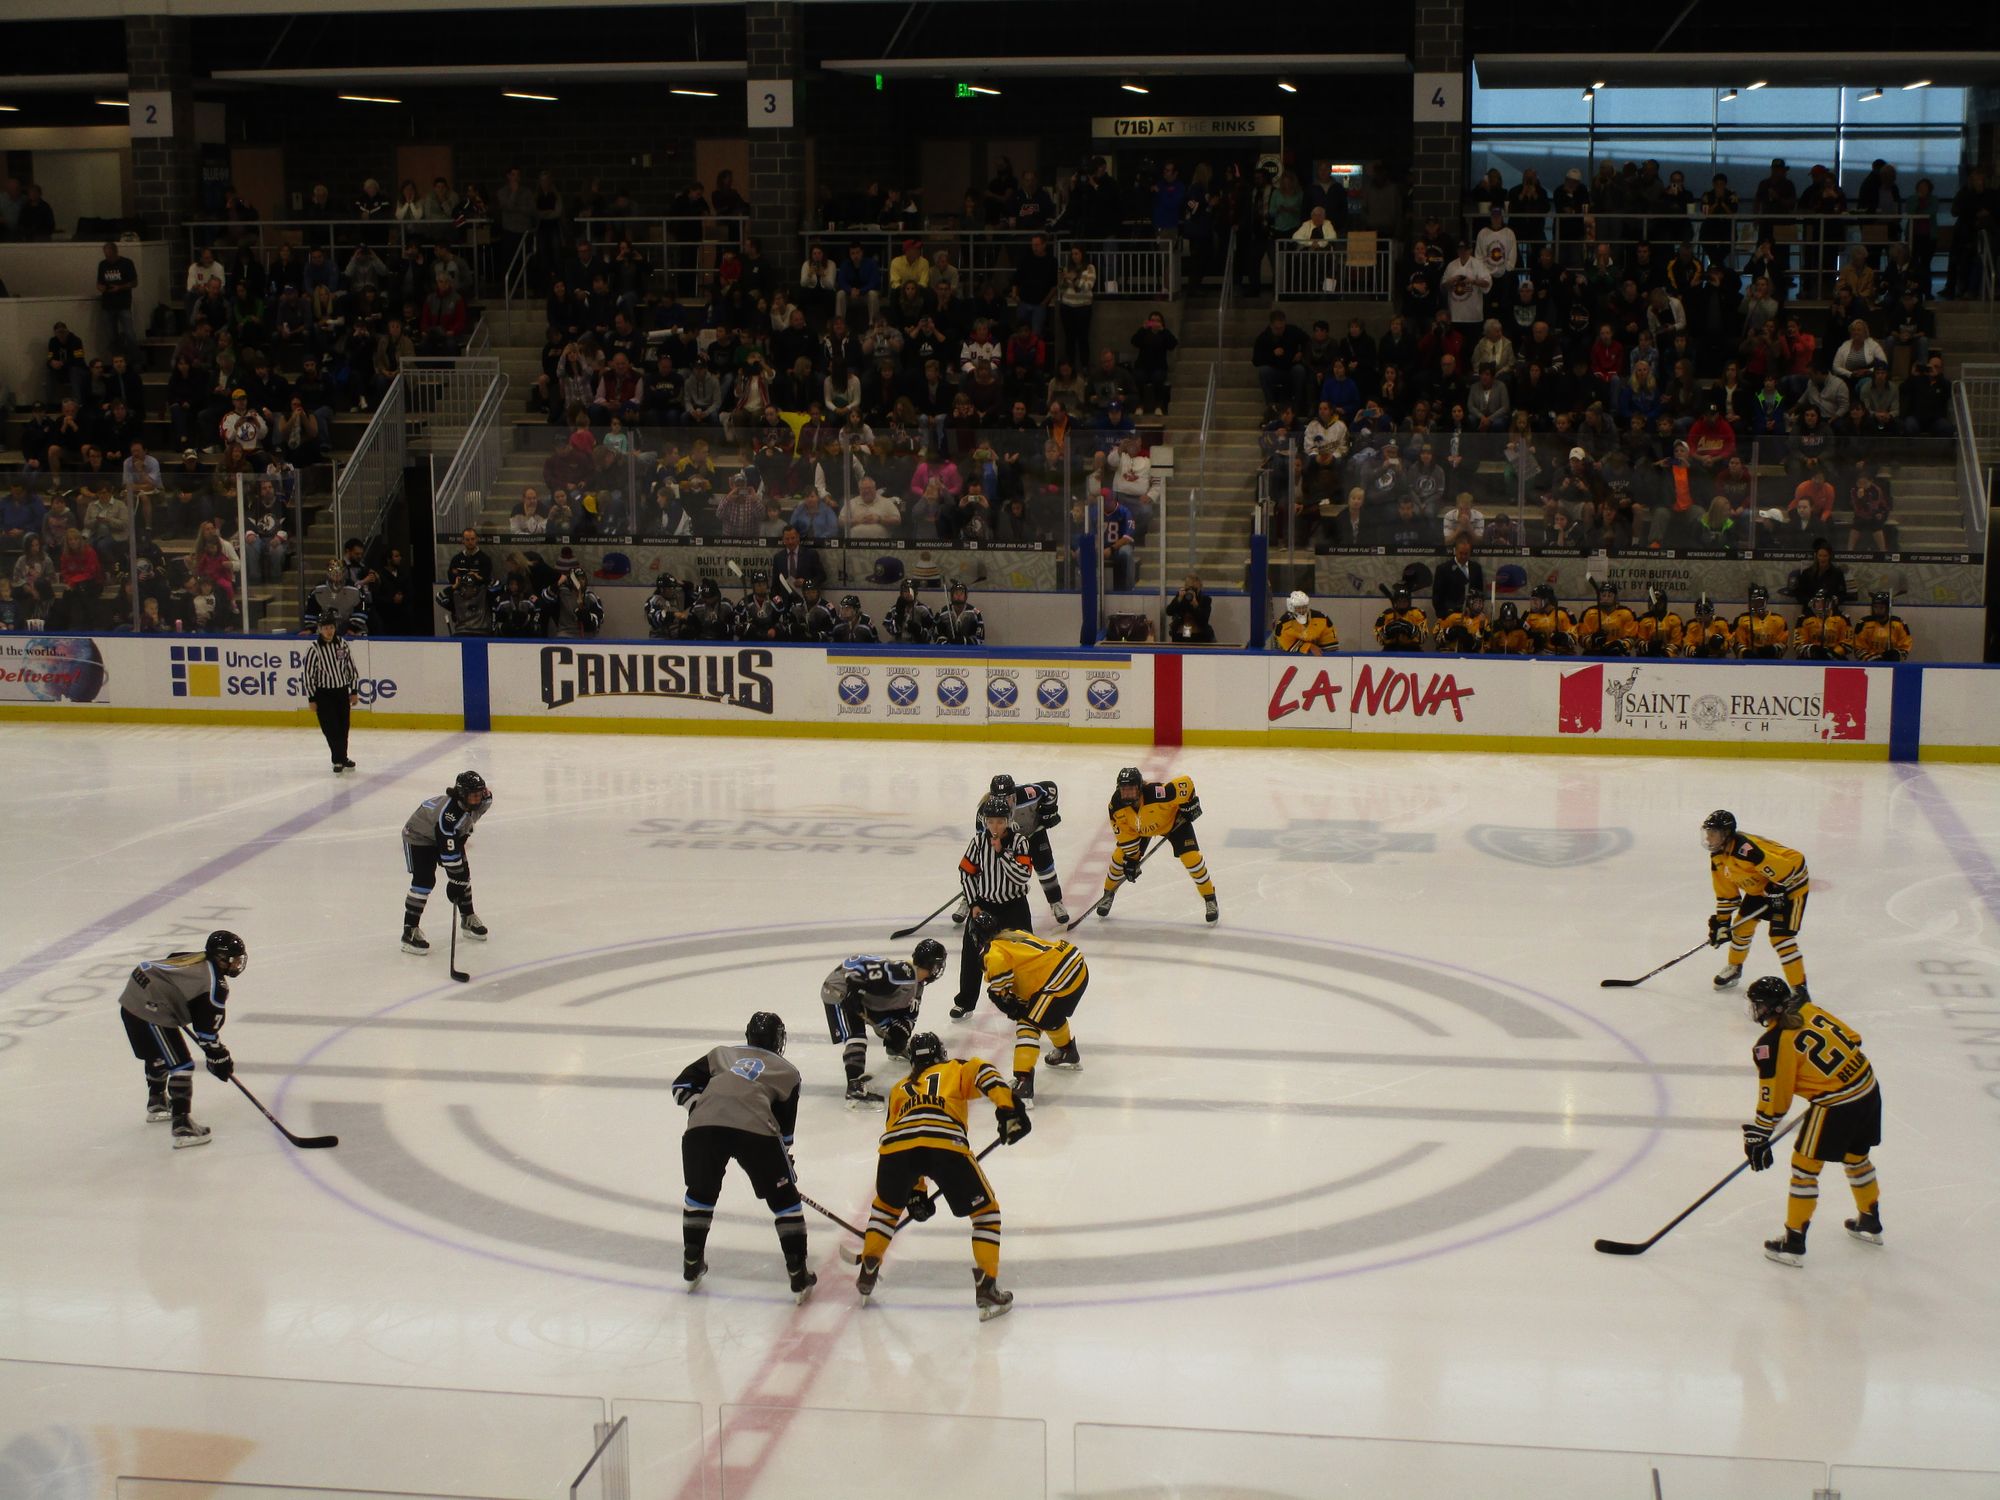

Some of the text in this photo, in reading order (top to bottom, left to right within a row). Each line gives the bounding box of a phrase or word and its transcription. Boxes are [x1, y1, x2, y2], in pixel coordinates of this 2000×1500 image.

[764, 94, 776, 113] 3
[1431, 87, 1445, 107] 4
[145, 105, 157, 124] 2
[1114, 120, 1255, 136] (716) AT THE RINKS
[697, 557, 723, 566] BUILT
[699, 567, 724, 577] BUILT
[1629, 569, 1647, 578] FOR
[1631, 581, 1643, 590] BY
[6, 645, 23, 656] the
[25, 646, 67, 657] world...
[226, 651, 282, 669] Uncle
[227, 671, 277, 696] self
[540, 646, 774, 715] CANISIUS
[1268, 664, 1476, 722] LA NOVA
[1625, 692, 1691, 714] SAINT
[1730, 695, 1821, 717] FRANCIS
[626, 817, 969, 842] SENECA
[446, 838, 455, 851] 9
[646, 839, 918, 855] RESORTS
[1763, 865, 1776, 878] 9
[866, 963, 883, 980] 13
[213, 1014, 223, 1029] 7
[1793, 1013, 1860, 1079] 22
[901, 1071, 942, 1098] 11
[1761, 1086, 1770, 1102] 2
